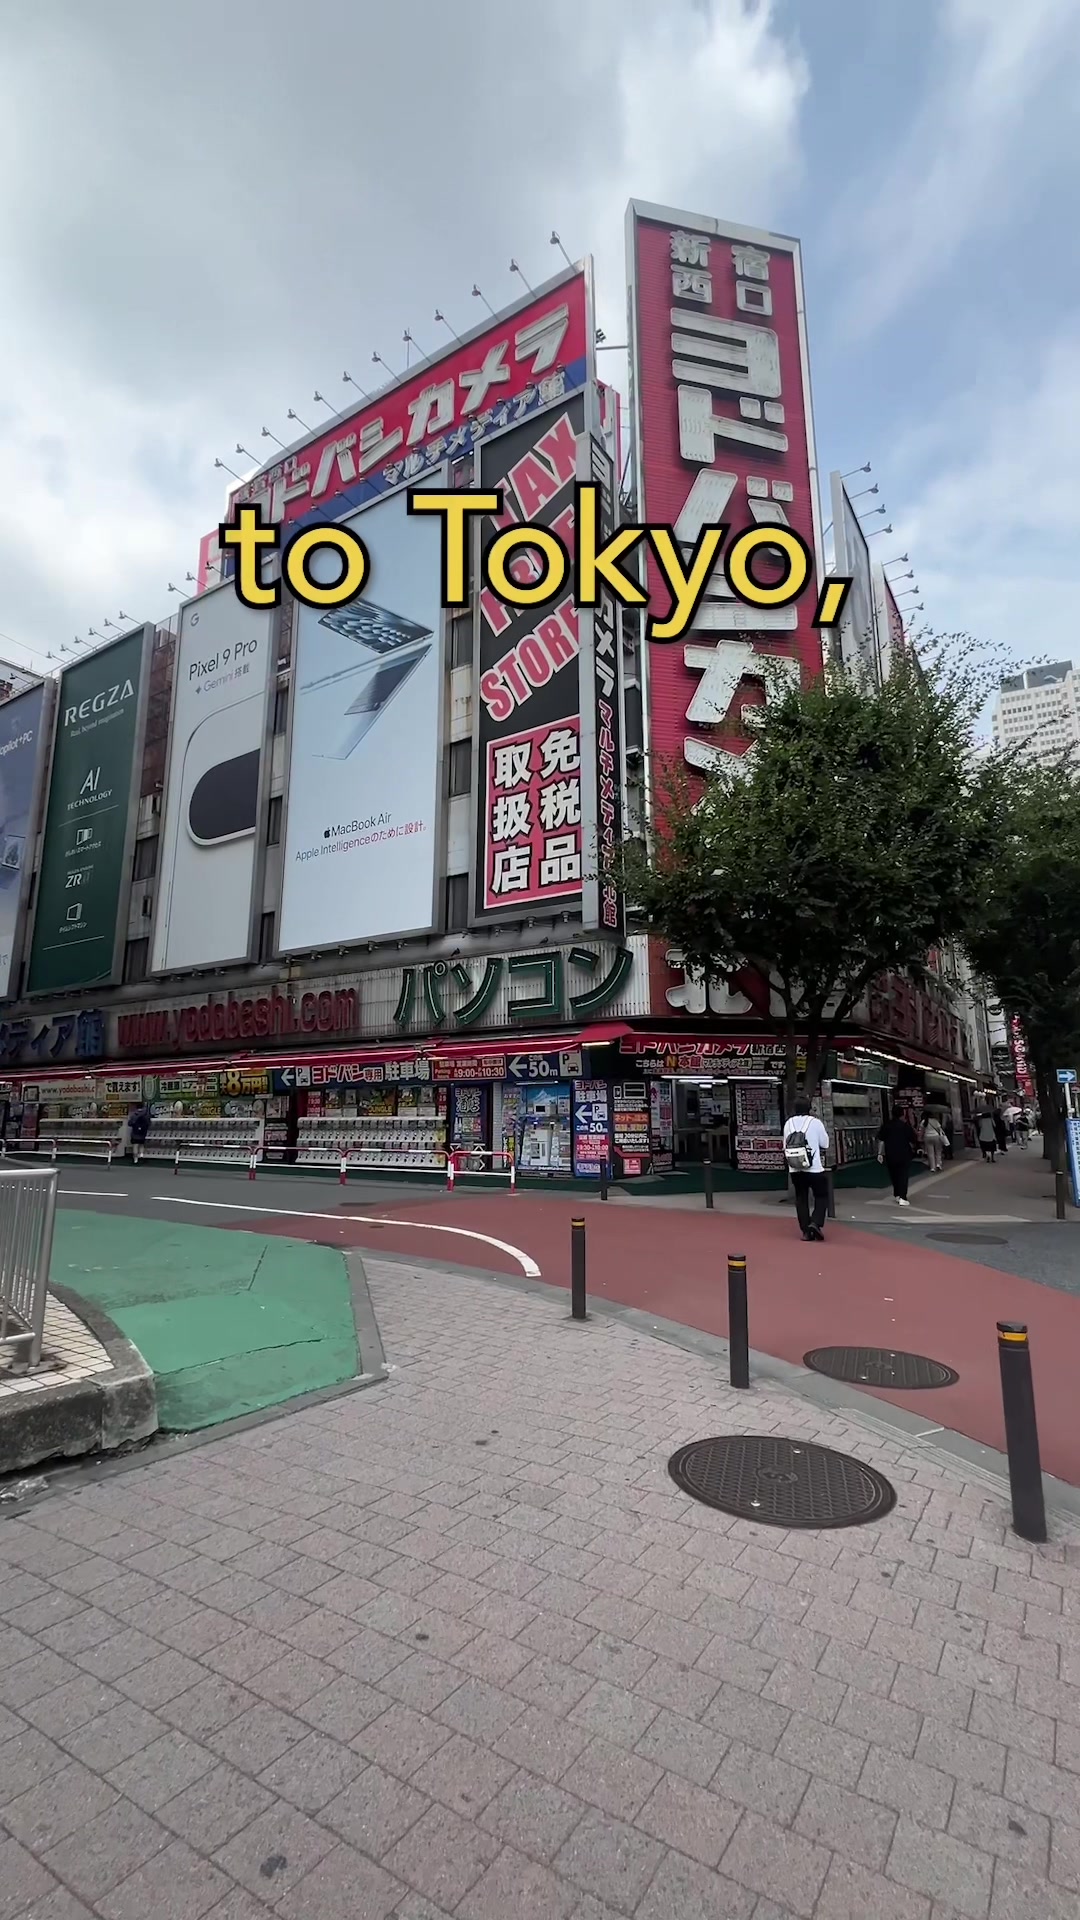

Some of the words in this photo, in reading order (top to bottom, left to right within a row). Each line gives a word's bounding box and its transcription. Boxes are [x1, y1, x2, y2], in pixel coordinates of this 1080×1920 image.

[669, 230, 772, 282] 新宿
[669, 263, 774, 317] 西口
[189, 652, 219, 681] Pixel
[222, 648, 231, 666] 9
[234, 639, 258, 661] Pro
[64, 678, 135, 727] REGZA
[67, 789, 113, 811] TECHNOLOGY
[80, 766, 101, 795] AI
[331, 816, 377, 837] MacBook
[378, 812, 392, 826] Air
[491, 742, 533, 895] 取扱店
[540, 727, 581, 889] 免税品
[295, 847, 320, 862] Apple
[394, 946, 635, 1028] パソコン
[117, 985, 359, 1050] www.yodobashi.com
[528, 1060, 558, 1078] 50m
